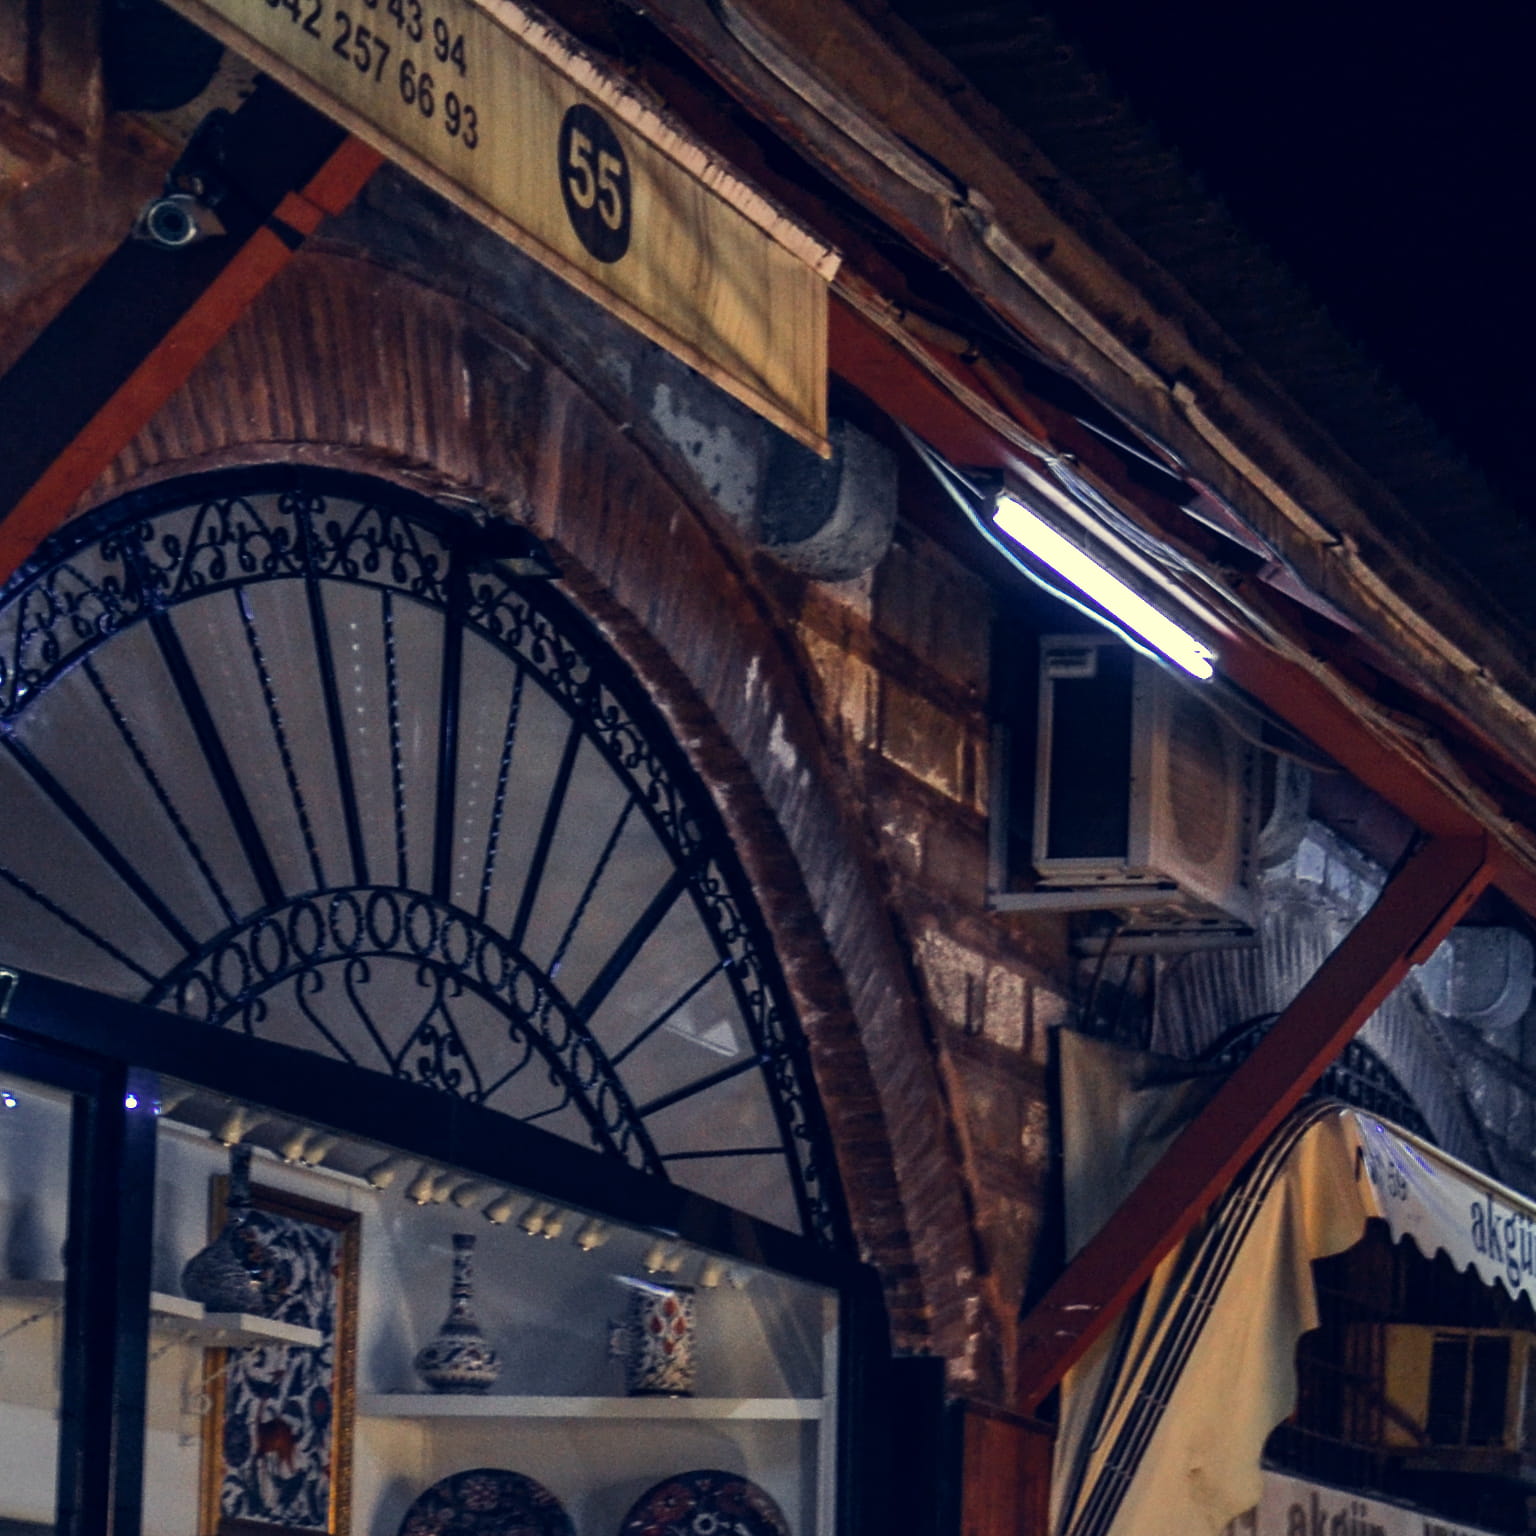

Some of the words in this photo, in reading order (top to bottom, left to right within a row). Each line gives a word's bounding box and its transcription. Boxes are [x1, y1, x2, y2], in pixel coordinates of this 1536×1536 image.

[332, 11, 391, 82] 257
[400, 58, 434, 118] 66
[445, 91, 479, 150] 93
[433, 17, 467, 78] 94
[568, 127, 623, 231] 55
